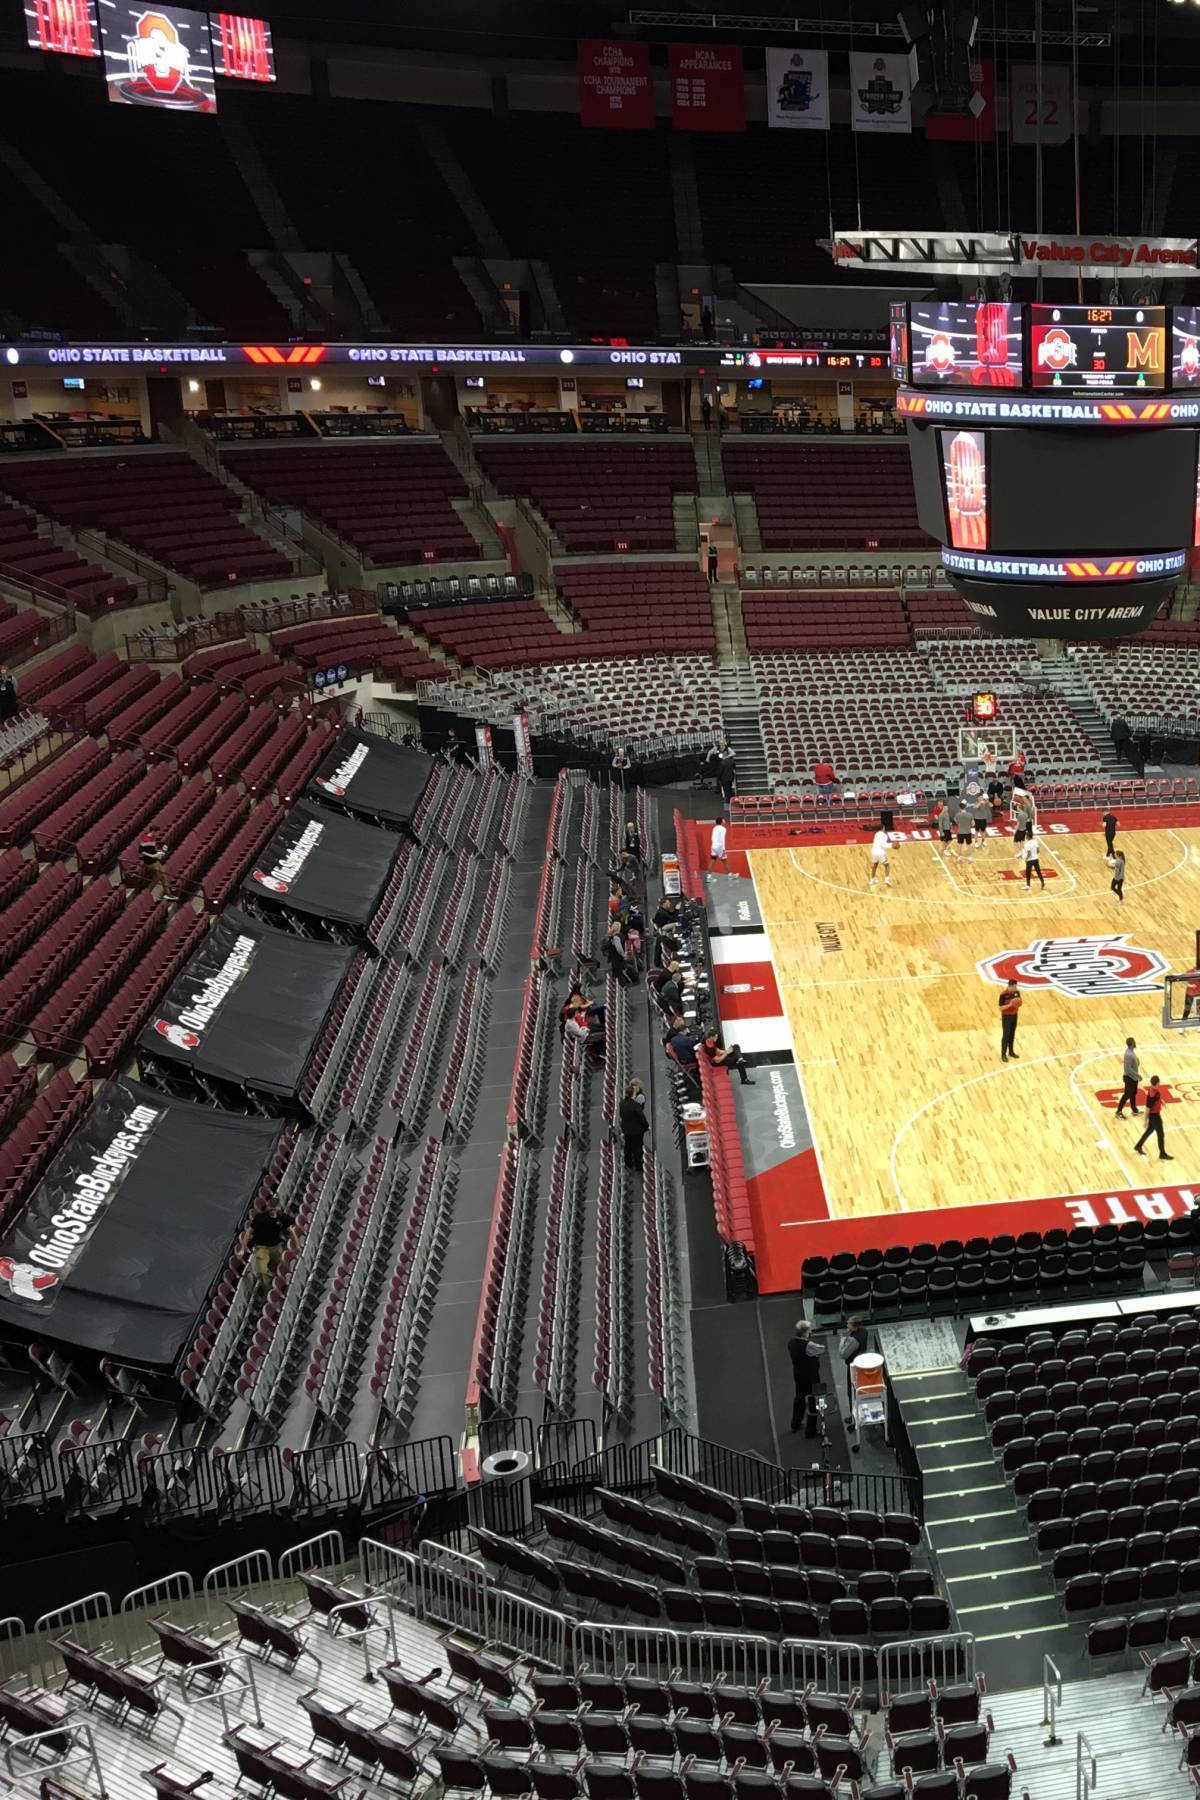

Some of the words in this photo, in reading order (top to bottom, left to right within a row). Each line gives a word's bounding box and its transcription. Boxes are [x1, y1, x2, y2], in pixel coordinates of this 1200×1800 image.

[593, 56, 634, 67] CHAMPIONS
[680, 59, 732, 72] APPEARANCES
[596, 86, 637, 96] CHAMPIONS
[1025, 99, 1058, 125] 22
[1021, 241, 1086, 261] Value
[1089, 243, 1134, 267] City
[1135, 244, 1197, 265] Arena
[1087, 309, 1112, 321] 16:27
[49, 349, 81, 362] OHIO
[83, 350, 129, 361] STATE
[133, 350, 226, 361] BASKETBALL
[348, 349, 387, 361] OHIO
[390, 350, 433, 361] STATE
[436, 350, 526, 362] BASKETBALL
[610, 352, 647, 363] OHIO
[827, 356, 851, 366] 16:27
[870, 356, 881, 366] 30
[1093, 360, 1105, 370] 30
[925, 399, 953, 414] OHIO
[955, 401, 996, 417] STATE
[1000, 402, 1103, 419] BASKETBALL
[1170, 403, 1198, 418] OHIO
[950, 555, 975, 570] STATE
[977, 559, 1066, 576] BASKETBALL
[1136, 559, 1164, 573] OHIO
[1027, 608, 1070, 621] VALUE
[1074, 608, 1106, 620] CITY
[1107, 605, 1144, 619] ARENA
[769, 1069, 796, 1150] OhioStateBuckeyes.com
[28, 1103, 159, 1269] OhioStateBuckeyes.com
